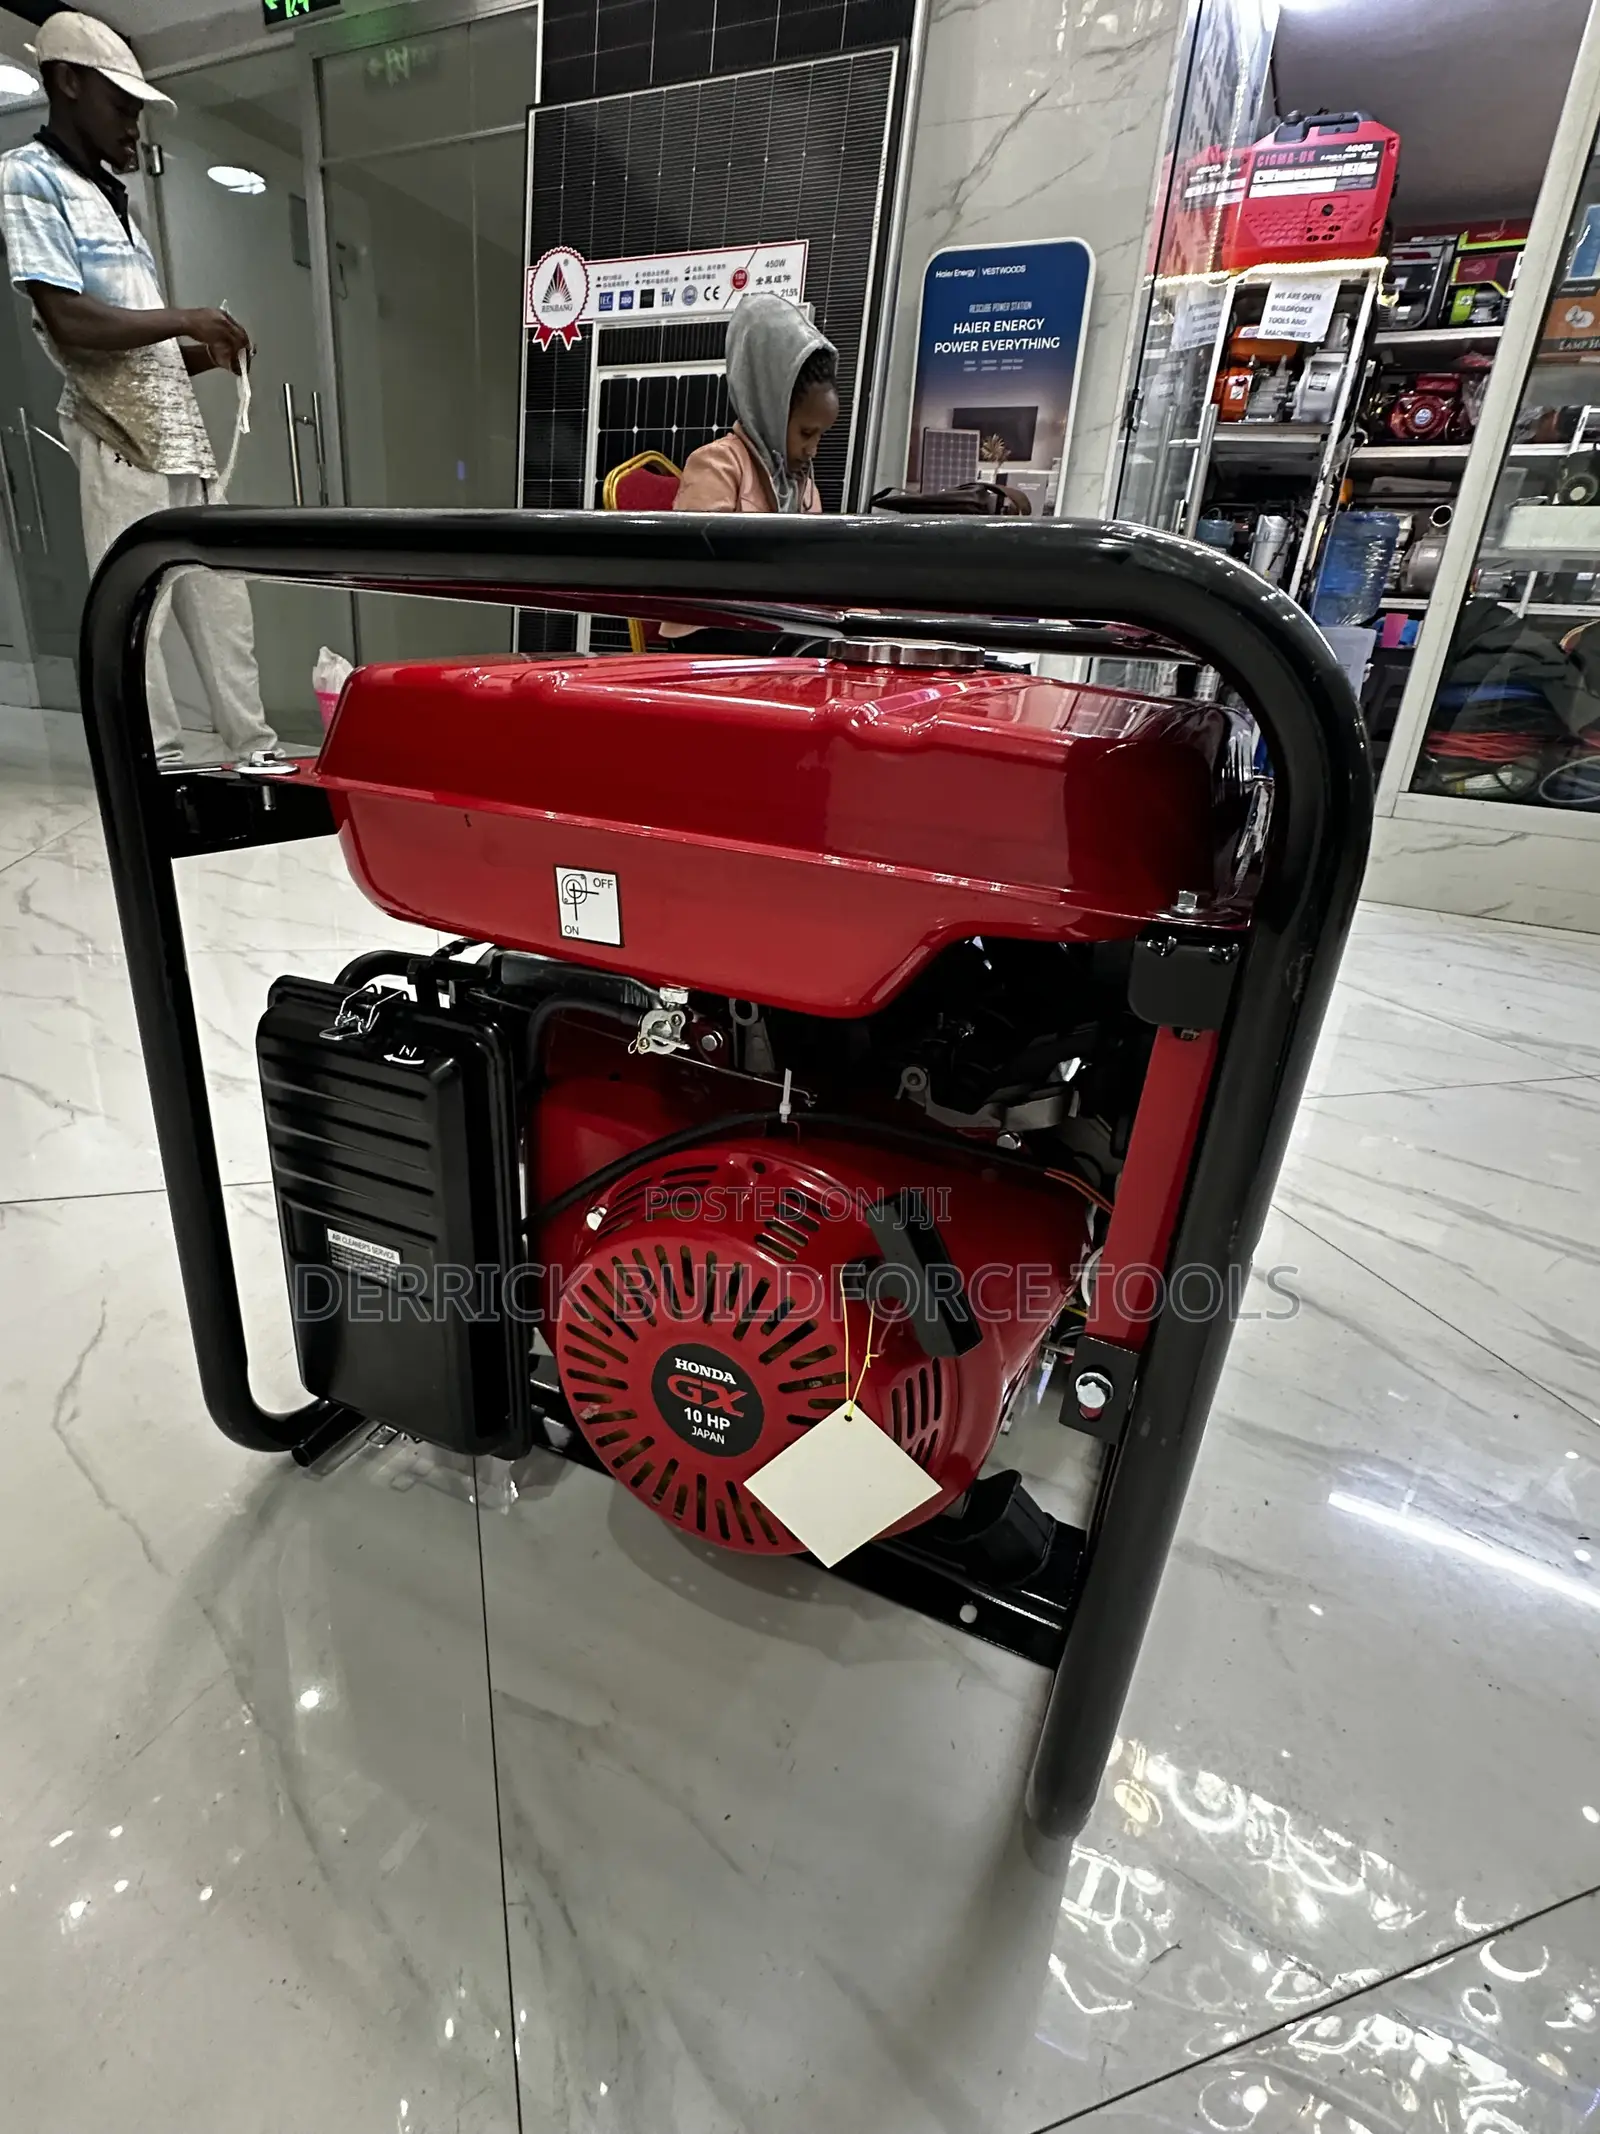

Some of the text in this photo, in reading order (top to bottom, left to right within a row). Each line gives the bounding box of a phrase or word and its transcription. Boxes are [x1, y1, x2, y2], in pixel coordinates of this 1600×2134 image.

[765, 259, 786, 268] 450W
[954, 268, 976, 278] Energy
[704, 286, 720, 301] CE
[953, 318, 1045, 334] HAIER ENERGY
[934, 337, 1060, 353] POWER EVERYTHING
[593, 878, 613, 889] OFF
[564, 925, 579, 936] ON
[675, 1358, 737, 1385] HONDA
[668, 1375, 747, 1417] GX
[684, 1407, 730, 1431] 10 HP
[691, 1426, 725, 1445] JAPAN
